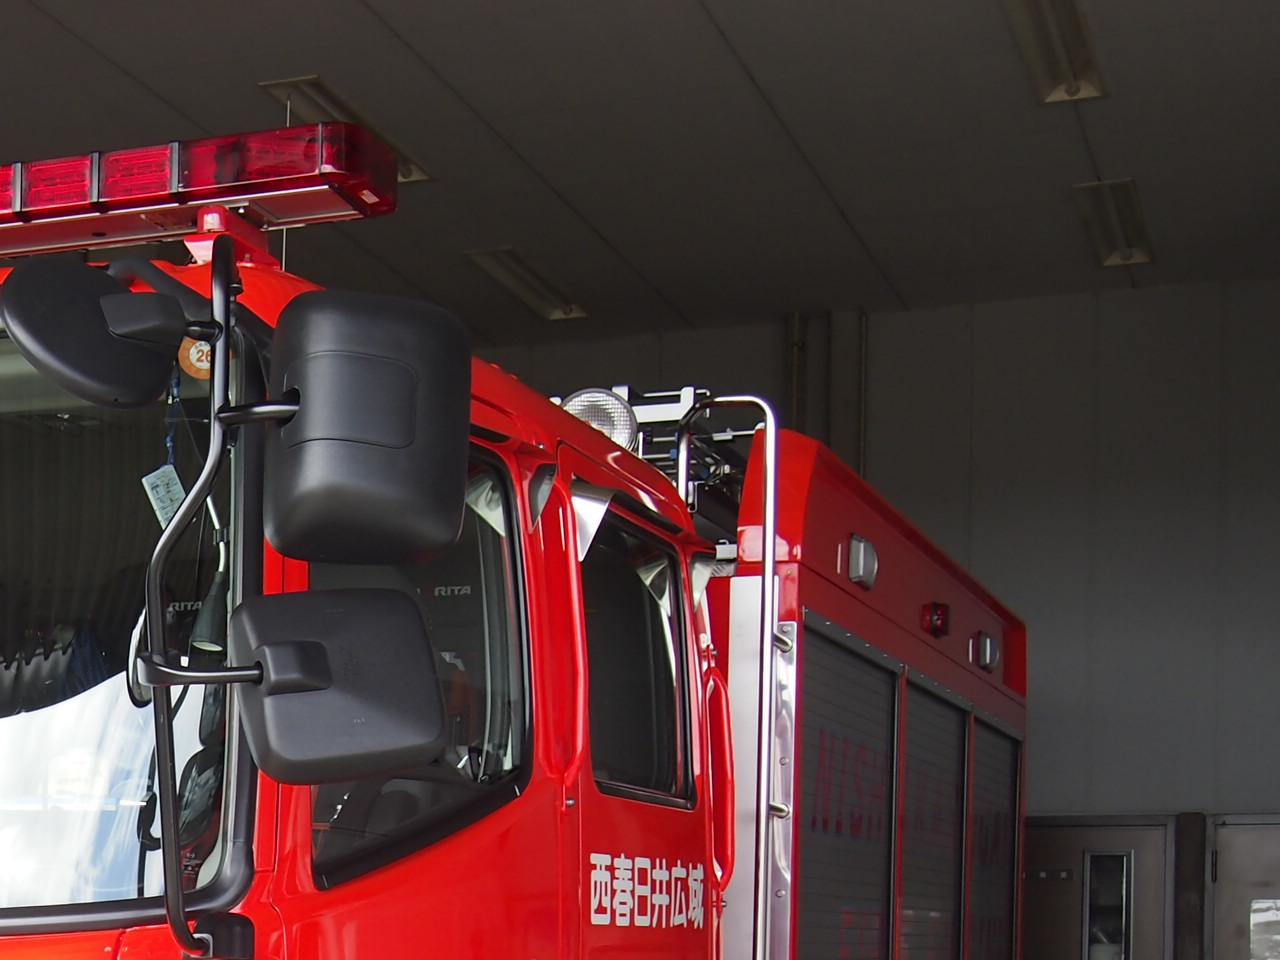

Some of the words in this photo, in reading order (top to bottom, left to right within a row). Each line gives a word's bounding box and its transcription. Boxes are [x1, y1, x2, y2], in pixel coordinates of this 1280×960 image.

[589, 852, 705, 929] 西春日井広域
